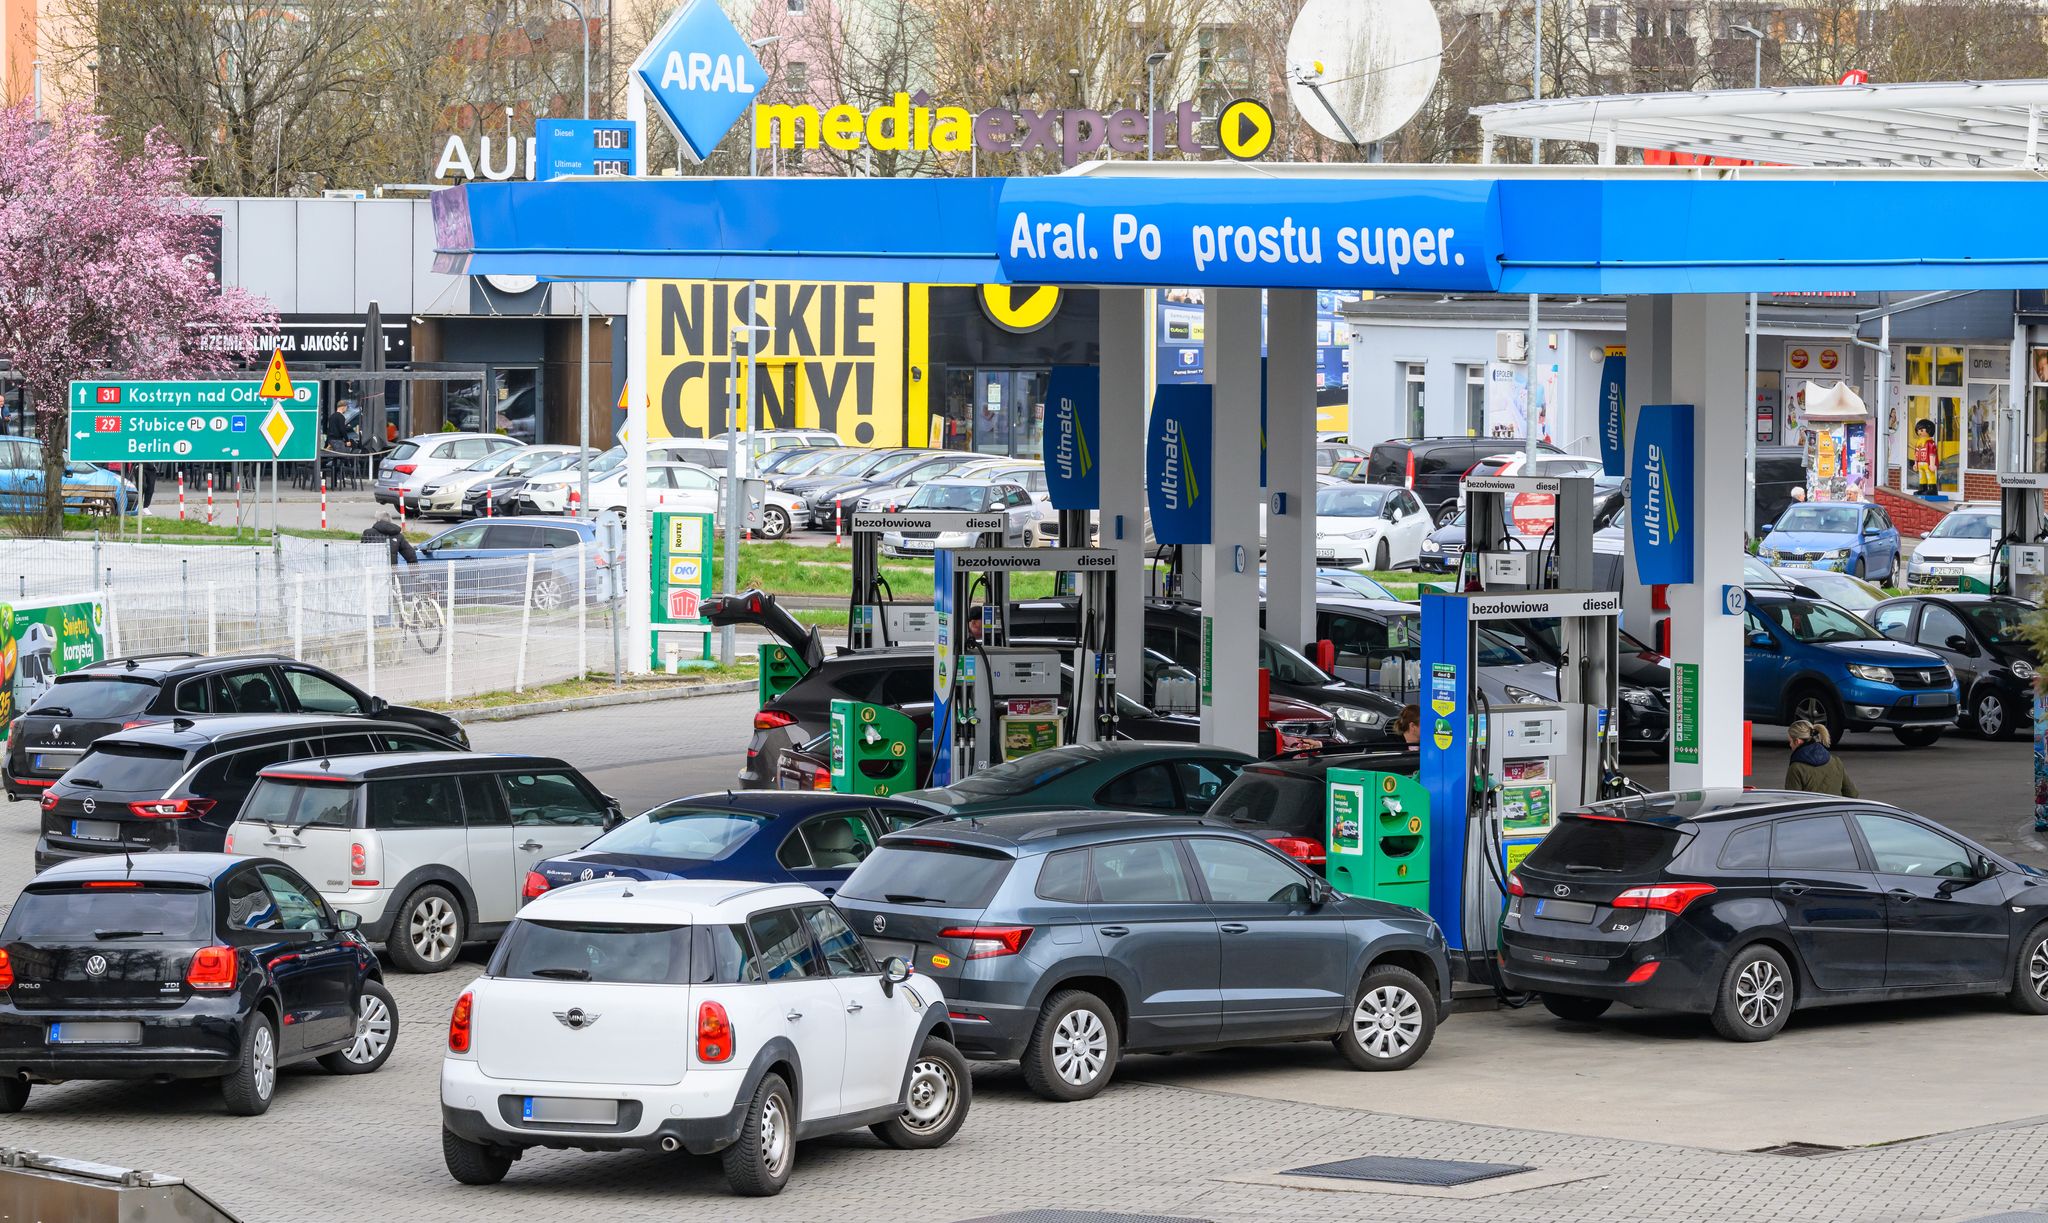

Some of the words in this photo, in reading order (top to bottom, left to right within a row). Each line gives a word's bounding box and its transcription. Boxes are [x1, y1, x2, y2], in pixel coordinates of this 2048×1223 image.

[661, 51, 755, 94] ARAL
[554, 128, 574, 137] Diesel
[554, 160, 582, 168] Ultimate
[1011, 211, 1098, 261] Aral.
[1113, 213, 1162, 261] Po
[1193, 216, 1323, 272] prostu
[1337, 224, 1465, 274] super.
[661, 283, 875, 357] NISKIE
[300, 332, 348, 351] JAKOŚĆ
[353, 335, 358, 351] I
[102, 389, 115, 401] 31
[129, 388, 191, 406] Kostrzyn
[198, 388, 225, 402] nad
[299, 389, 306, 400] D
[661, 360, 875, 444] CENY!
[101, 419, 116, 431] 29
[129, 416, 185, 432] Słubice
[190, 419, 202, 429] PL
[215, 419, 222, 430] D
[1608, 382, 1618, 451] ultimate
[128, 438, 170, 453] Berlin
[179, 442, 186, 453] D
[1061, 396, 1073, 479] ultimate
[1165, 418, 1178, 510] ultimate
[1467, 480, 1515, 490] bezołowiowa
[1536, 482, 1559, 491] diesel
[1624, 483, 1630, 494] 4
[1645, 444, 1660, 546] ultimate
[854, 517, 931, 529] bezołowiowa
[966, 517, 1001, 529] diesel
[957, 555, 1041, 567] bezołowiowa
[1077, 554, 1115, 567] diesel
[674, 566, 697, 575] DKV
[1472, 601, 1549, 615] bezołowiowa
[1582, 598, 1617, 611] diesel
[1729, 593, 1742, 609] 12
[63, 612, 90, 638] Świętuj,
[63, 638, 94, 664] korzystaj
[1507, 729, 1514, 737] 12
[568, 1014, 585, 1023] MINI
